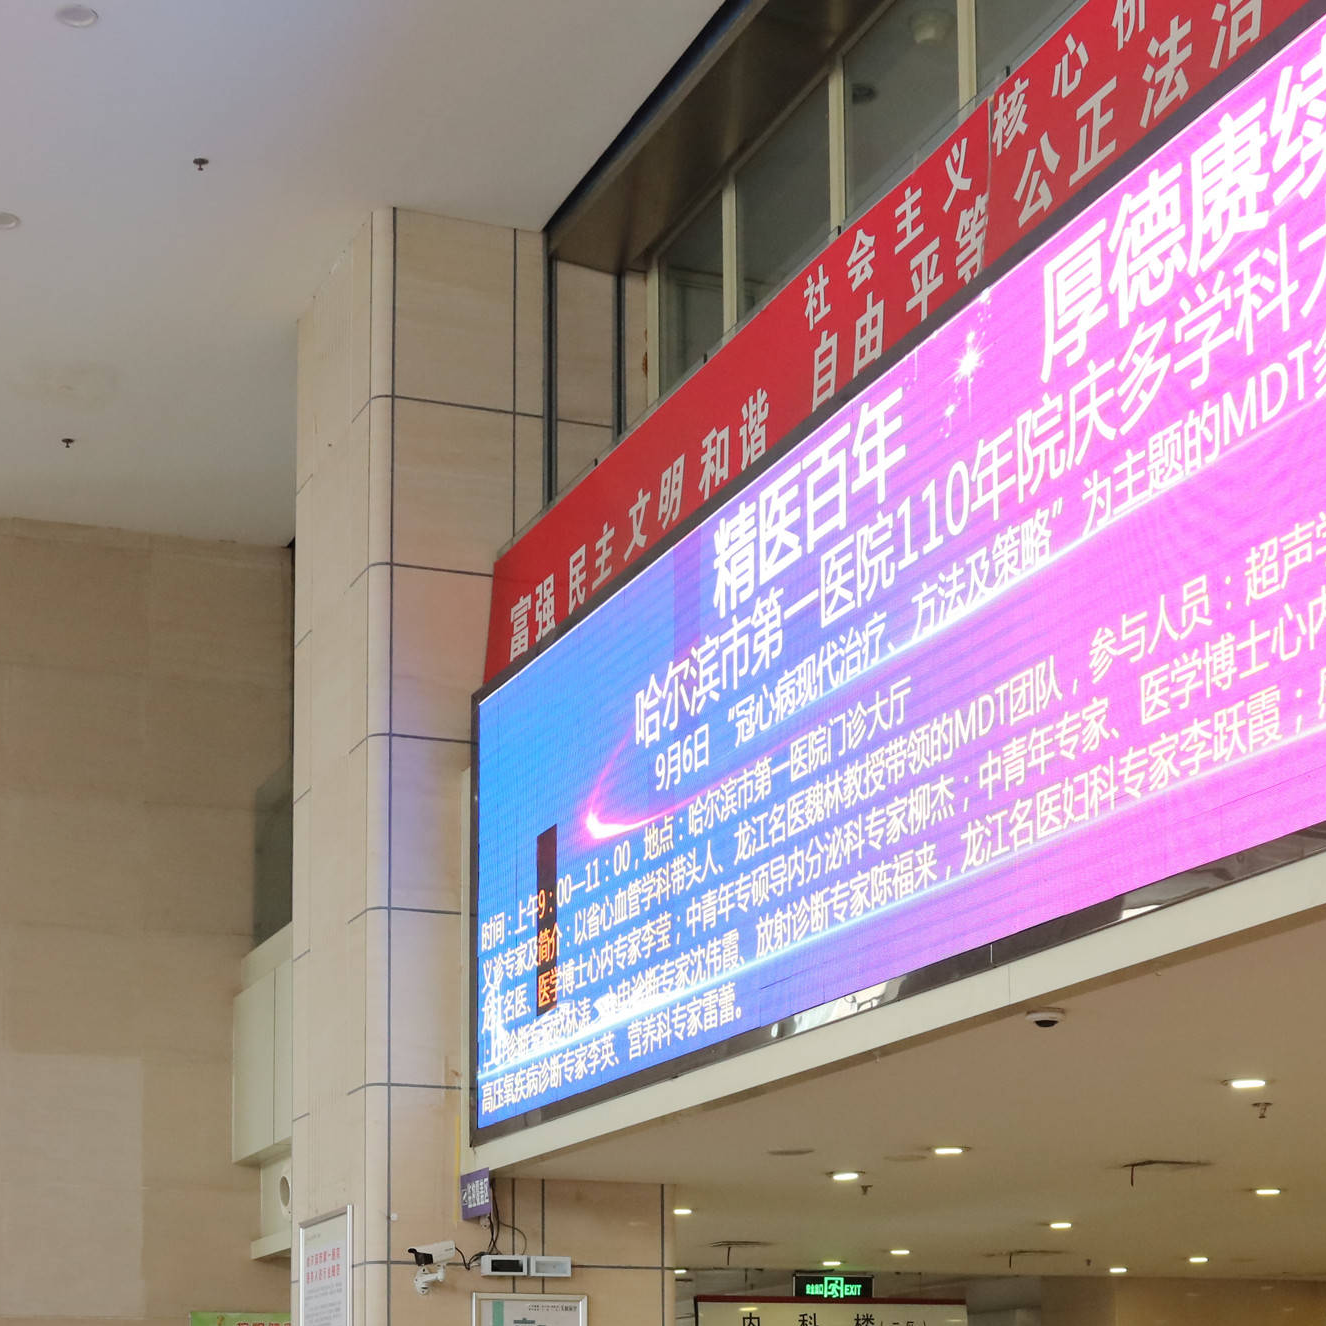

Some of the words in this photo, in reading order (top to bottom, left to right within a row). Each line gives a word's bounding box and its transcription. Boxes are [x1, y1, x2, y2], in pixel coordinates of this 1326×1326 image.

[509, 573, 557, 662] 富强
[569, 521, 613, 607] 民主
[623, 453, 686, 561] 文明
[698, 387, 770, 502] 和谐
[812, 294, 884, 412] 自由
[905, 194, 989, 321] 平等
[1013, 77, 1118, 229] 公正
[712, 387, 908, 618] 精医百年
[654, 726, 711, 790] 9月6日
[845, 1284, 862, 1296] EXIT
